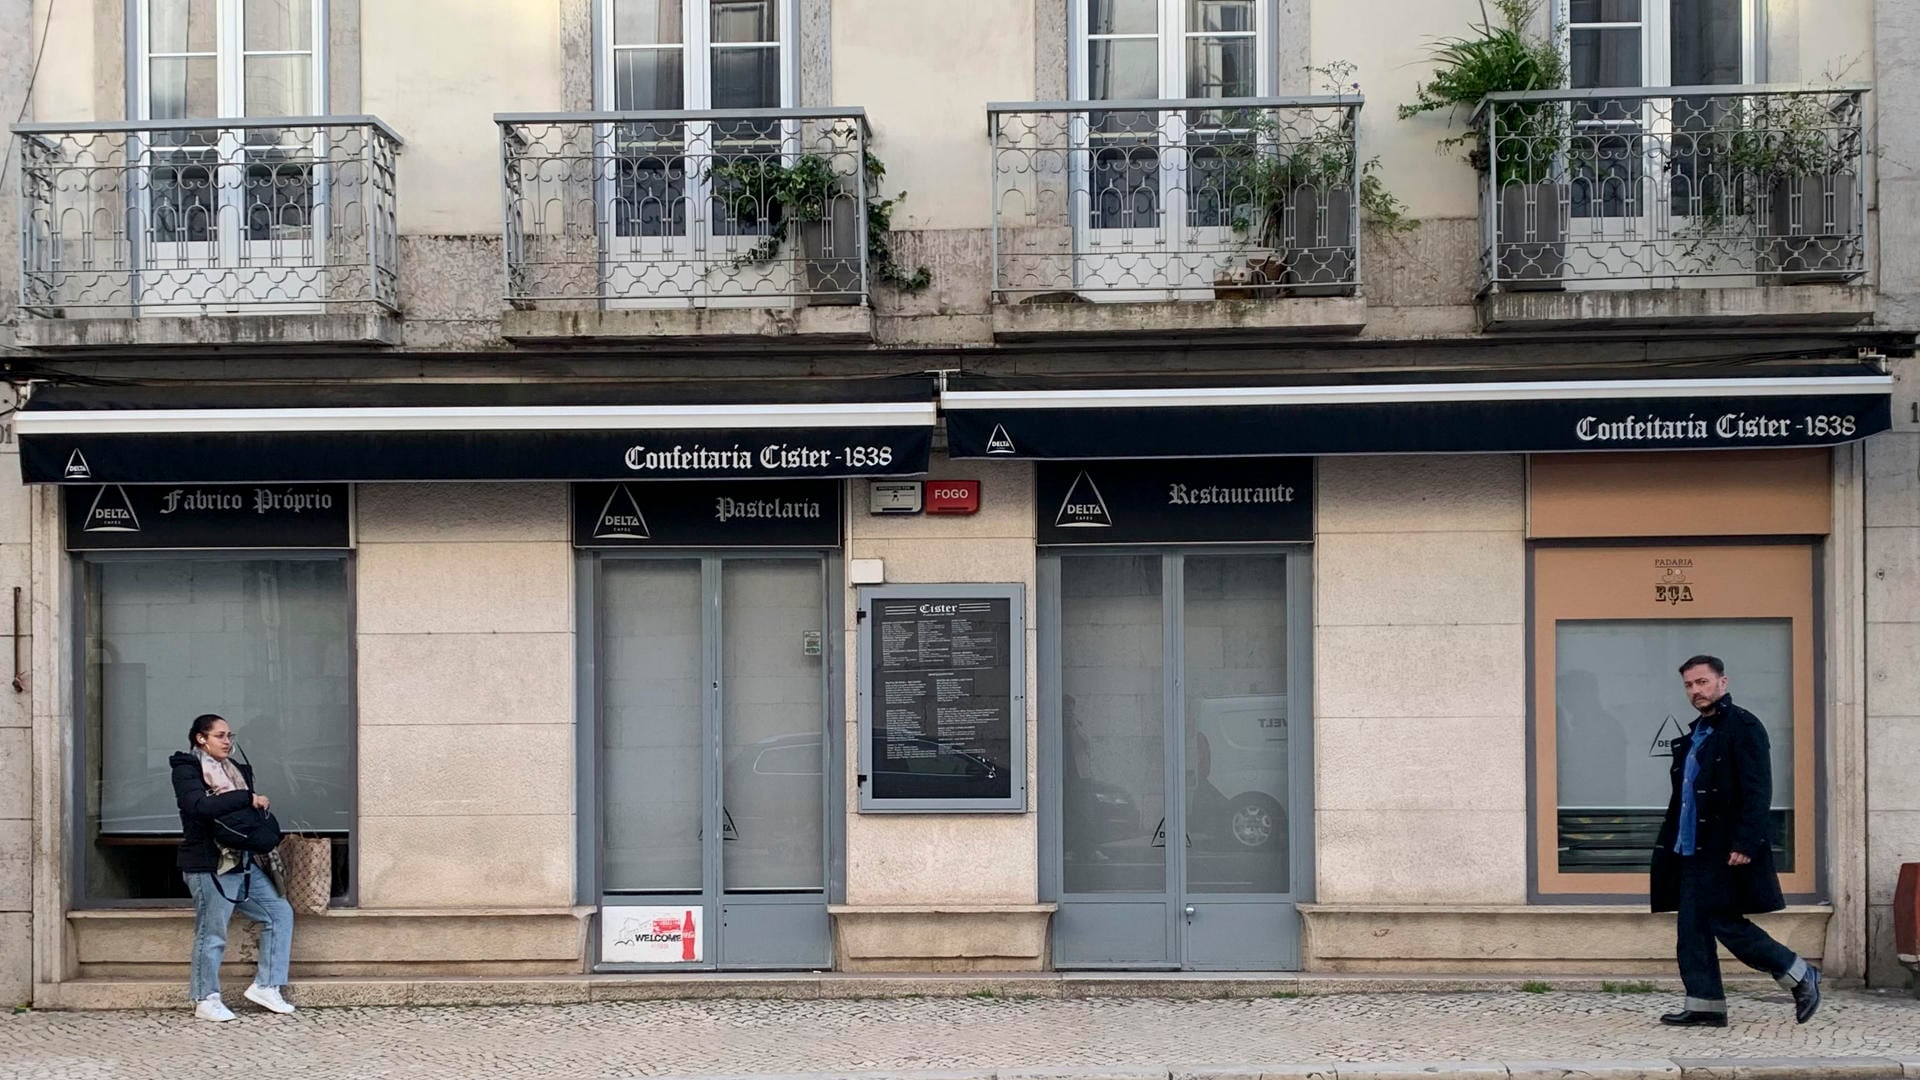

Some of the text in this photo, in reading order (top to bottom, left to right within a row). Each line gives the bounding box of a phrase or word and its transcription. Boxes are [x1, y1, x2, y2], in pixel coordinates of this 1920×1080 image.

[1576, 412, 1709, 441] Confeitaria
[1716, 412, 1791, 438] Cister
[625, 443, 752, 469] Confeitaria
[760, 443, 831, 469] Cister
[934, 489, 969, 499] FOGO
[1168, 483, 1295, 504] Restaurante
[160, 488, 332, 513] Fabrico Próprio
[95, 508, 130, 518] DELTA
[715, 496, 820, 522] Pastelaria
[1067, 504, 1102, 514] DELTA
[605, 515, 640, 526] DELTA
[920, 603, 957, 613] Cister
[635, 934, 682, 943] WELCOME
